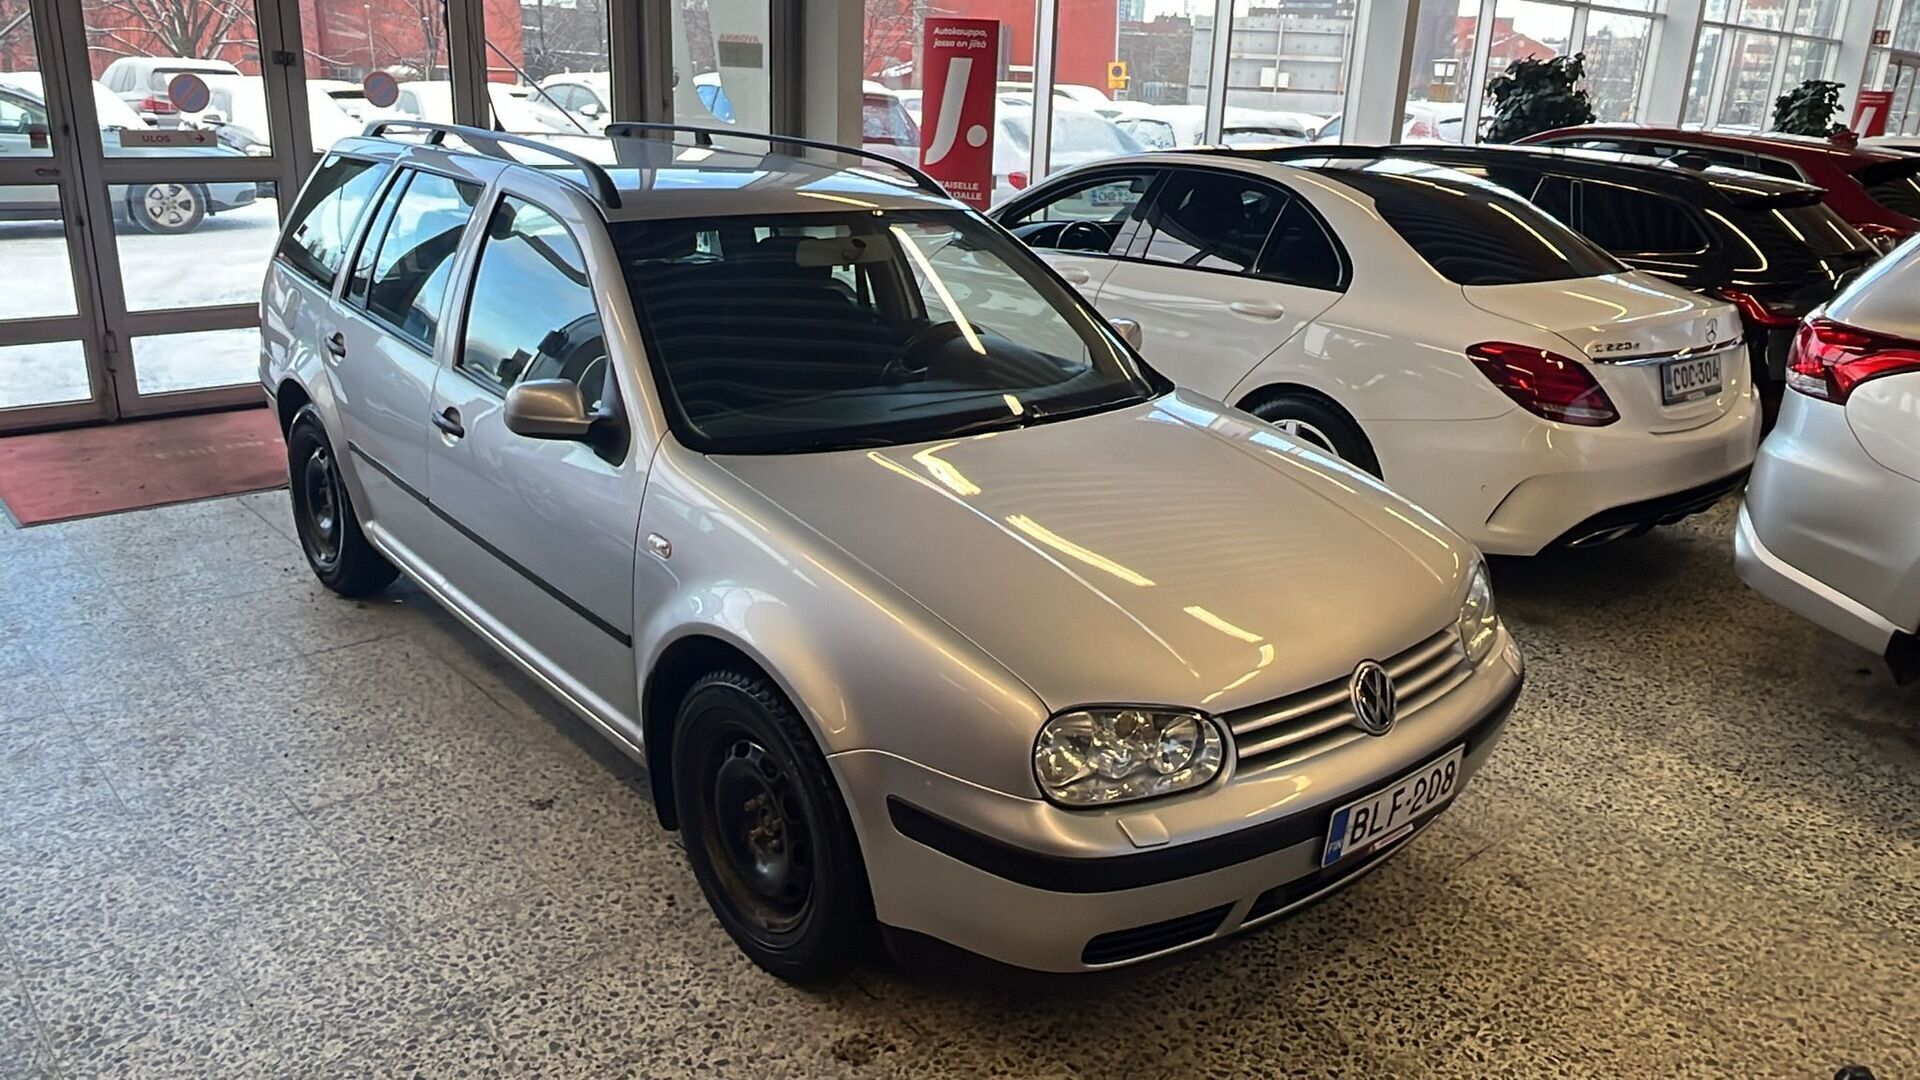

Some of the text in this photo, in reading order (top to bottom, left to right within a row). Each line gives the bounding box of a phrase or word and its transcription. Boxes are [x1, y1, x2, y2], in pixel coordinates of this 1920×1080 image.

[932, 26, 988, 38] Autokauppa,
[956, 40, 968, 49] on
[141, 134, 171, 143] ULOS
[1673, 358, 1720, 391] COC-304
[1349, 759, 1456, 846] BLF-208
